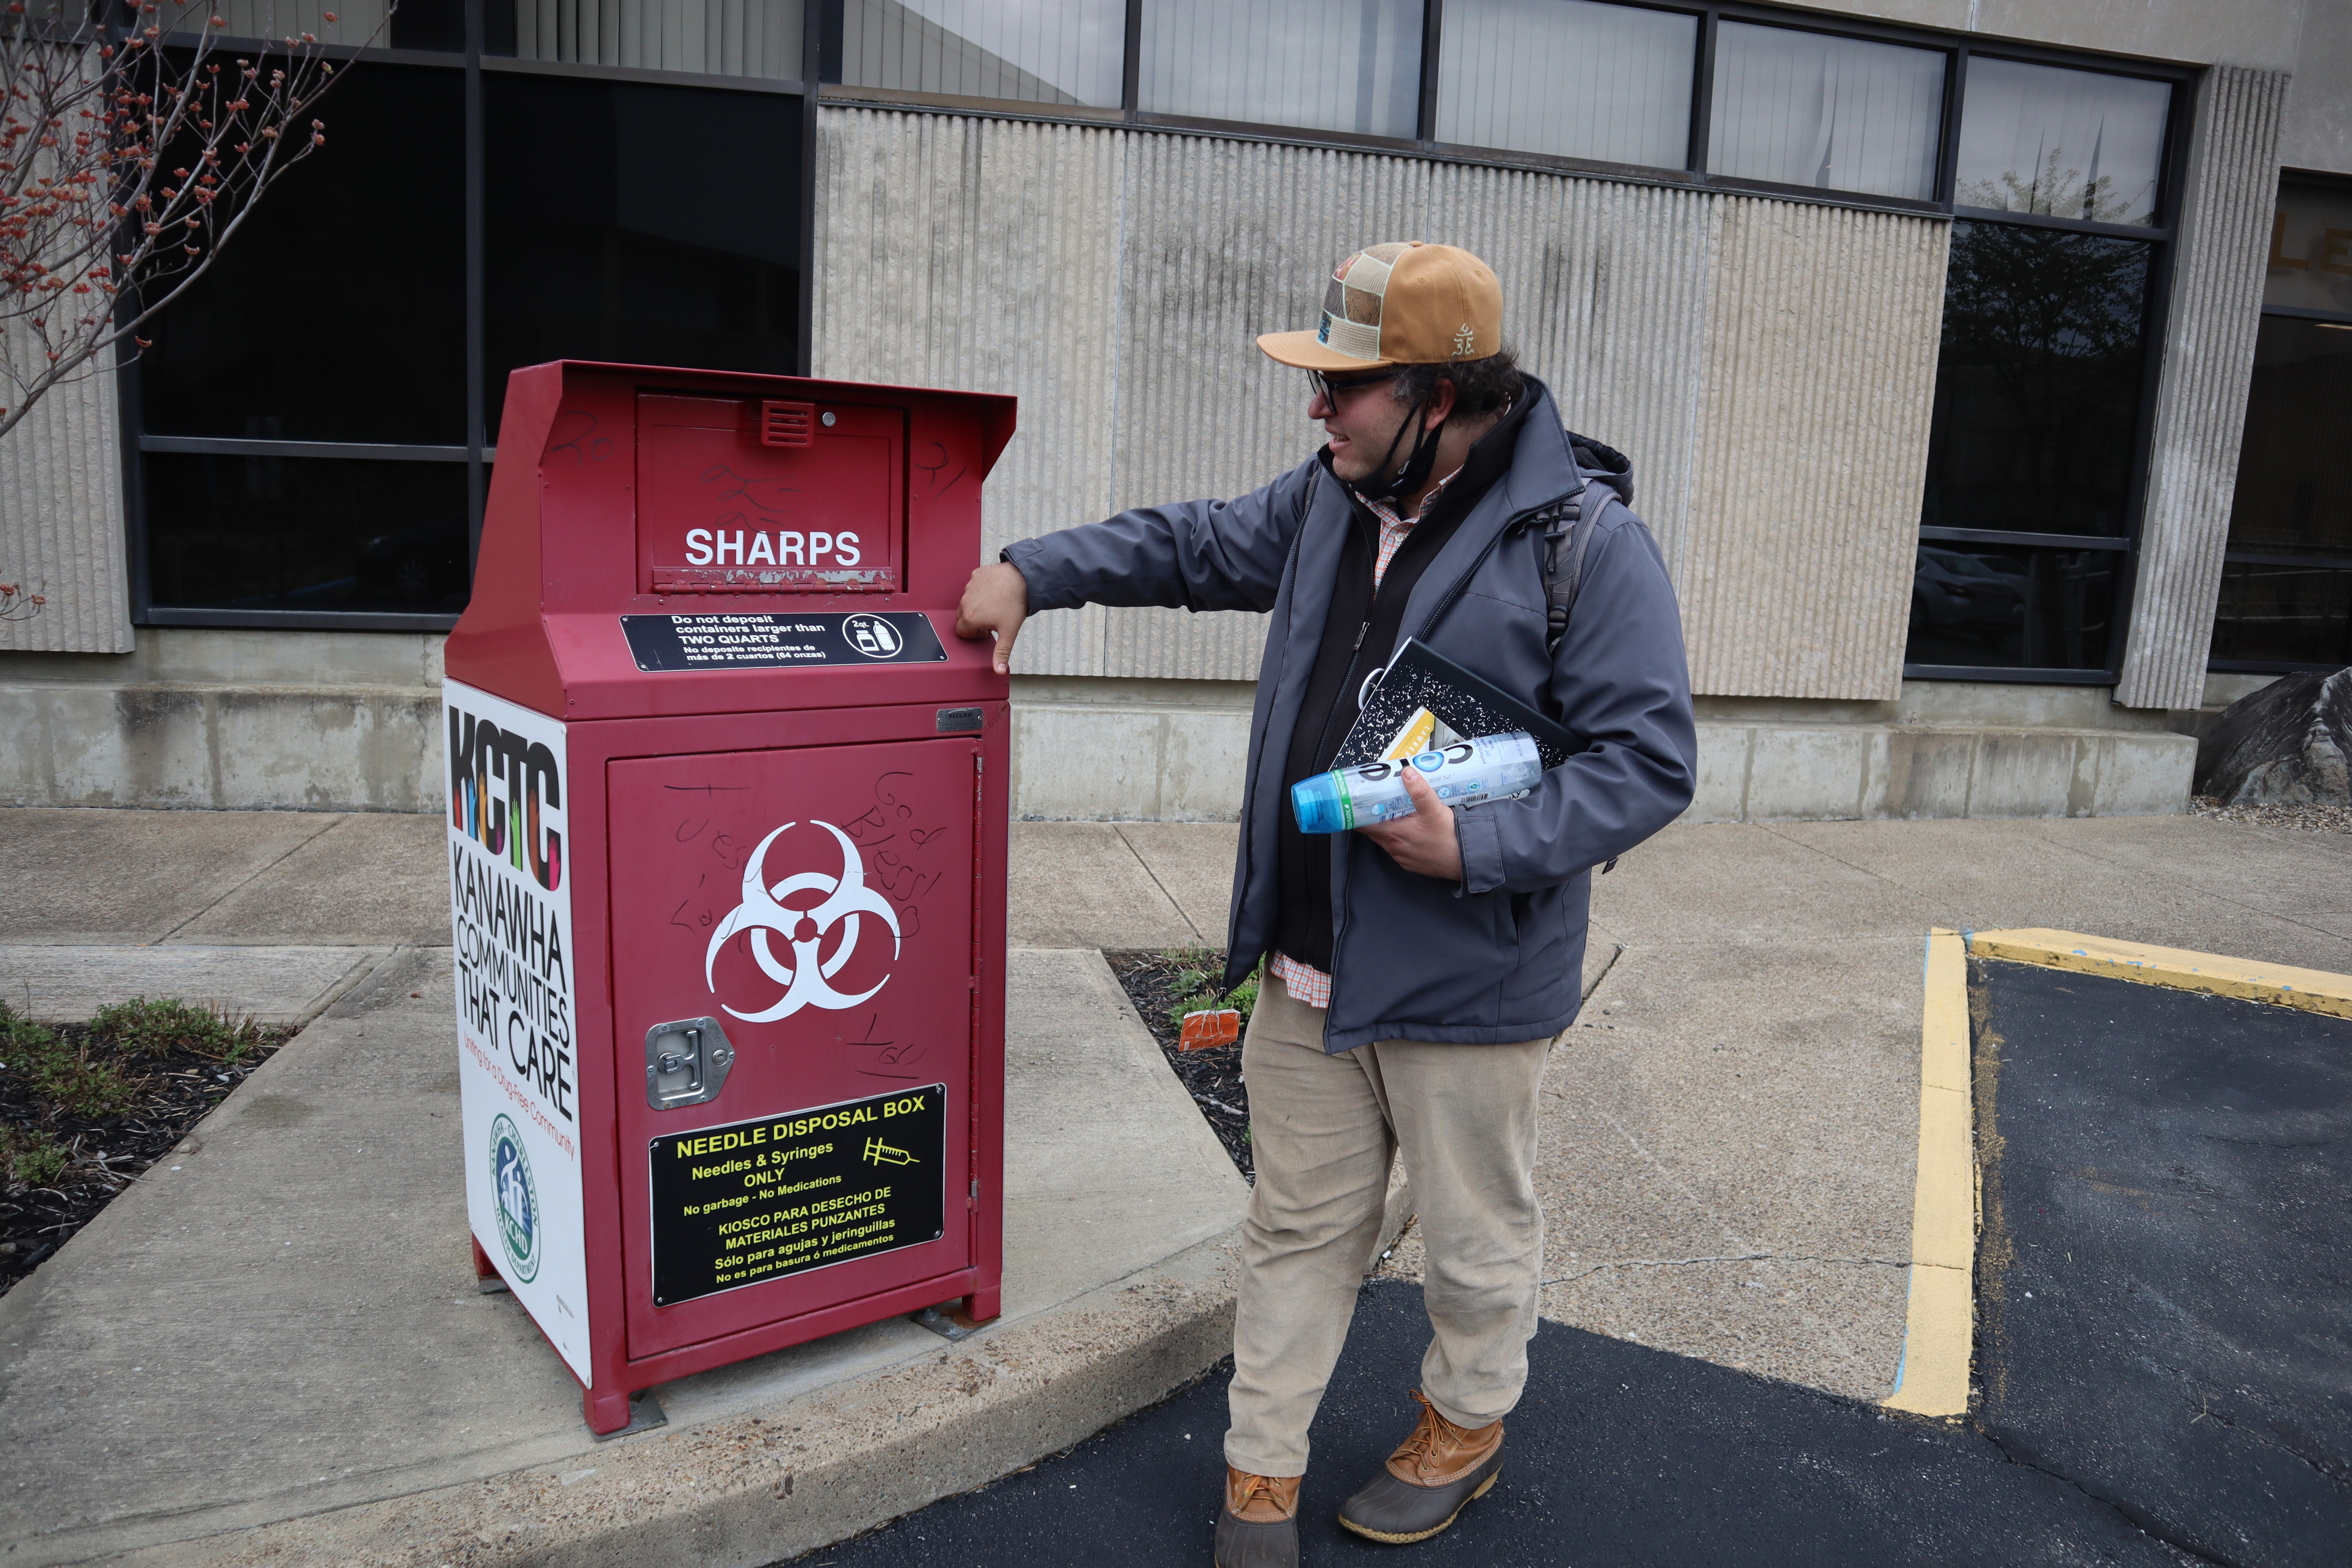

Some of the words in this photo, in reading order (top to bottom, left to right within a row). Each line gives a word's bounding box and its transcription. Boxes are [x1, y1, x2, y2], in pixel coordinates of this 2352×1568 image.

[686, 528, 860, 566] SHARPS
[671, 615, 692, 624] Do
[722, 615, 774, 625] deposit
[675, 624, 750, 633] containers
[752, 624, 792, 634] larger
[795, 624, 826, 632] than
[678, 635, 715, 644] TWO
[718, 634, 779, 644] QUARTS
[851, 620, 870, 628] 2qt.
[701, 646, 745, 654] deposite
[1404, 726, 1430, 757] LAWREN
[448, 704, 561, 891] KCTC
[454, 840, 567, 995] KANAWHA
[457, 914, 570, 1048] COMMUNITIES
[459, 959, 500, 1050] THAT
[508, 1010, 572, 1122] CARE
[464, 1031, 483, 1066] Uniting
[492, 1065, 497, 1078] a
[498, 1067, 528, 1112] Drug-Free
[530, 1101, 574, 1161] Community
[677, 1127, 766, 1158] NEEDLE
[773, 1107, 878, 1140] DISPOSAL
[884, 1095, 925, 1118] BOX
[491, 1120, 505, 1176] KANAWHA
[508, 1124, 538, 1227] CHARLESTON
[692, 1160, 752, 1180] Needles
[756, 1154, 767, 1167] &
[771, 1143, 833, 1165] Syringes
[744, 1167, 785, 1187] ONLY
[684, 1205, 700, 1216] No
[703, 1196, 749, 1214] garbage
[759, 1189, 775, 1200] No
[777, 1175, 842, 1196] Medications
[719, 1214, 770, 1236] KIOSCO
[774, 1206, 809, 1223] PARA
[811, 1191, 872, 1214] DESECHO
[875, 1186, 891, 1200] DE
[496, 1207, 510, 1254] HEALTH
[511, 1253, 536, 1275] DEPARTMENT
[504, 1212, 528, 1255] KCHD
[715, 1255, 744, 1270] Sólo
[747, 1249, 775, 1264] para
[778, 1238, 818, 1255] agujas
[821, 1235, 829, 1247] y
[831, 1220, 895, 1245] jeringuillas
[726, 1221, 808, 1250] MATERIALES
[811, 1203, 885, 1230] PUNZANTES
[716, 1274, 731, 1283] No
[734, 1270, 747, 1279] es
[750, 1264, 773, 1277] para
[775, 1255, 811, 1269] basura
[813, 1251, 820, 1259] ó
[823, 1234, 894, 1257] medicamentos
